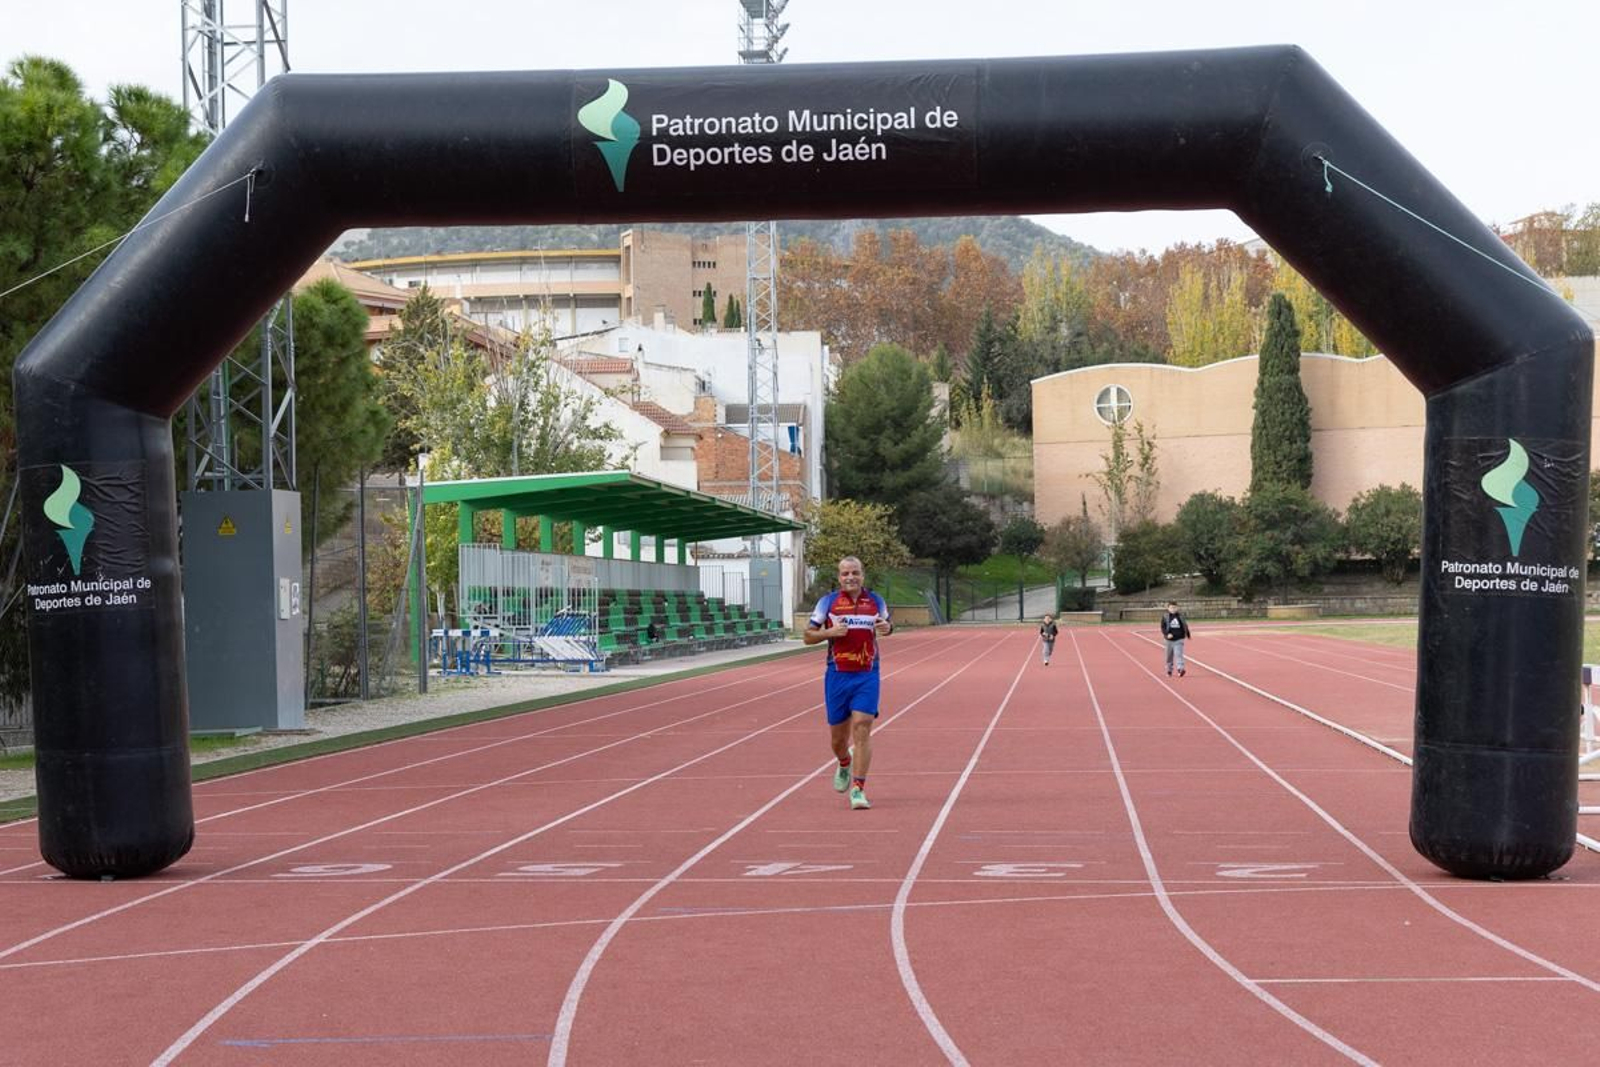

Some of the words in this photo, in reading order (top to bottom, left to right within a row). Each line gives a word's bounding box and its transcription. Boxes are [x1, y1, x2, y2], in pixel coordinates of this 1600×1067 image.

[651, 112, 779, 136] Patronato
[788, 106, 916, 136] Municipal
[924, 106, 959, 129] de
[652, 143, 773, 171] Deportes
[781, 139, 814, 162] de
[822, 136, 887, 162] Jaén
[1441, 560, 1502, 574] Patronato
[1506, 562, 1567, 579] Municipal
[1568, 566, 1580, 579] de
[27, 583, 68, 596] Patronato
[70, 577, 133, 592] Municipal
[136, 577, 152, 589] de
[1454, 576, 1517, 592] Deportes
[1520, 578, 1538, 591] de
[1541, 580, 1569, 593] Jaén
[35, 595, 82, 611] Deportes
[84, 594, 102, 606] de
[105, 593, 137, 605] Jaén
